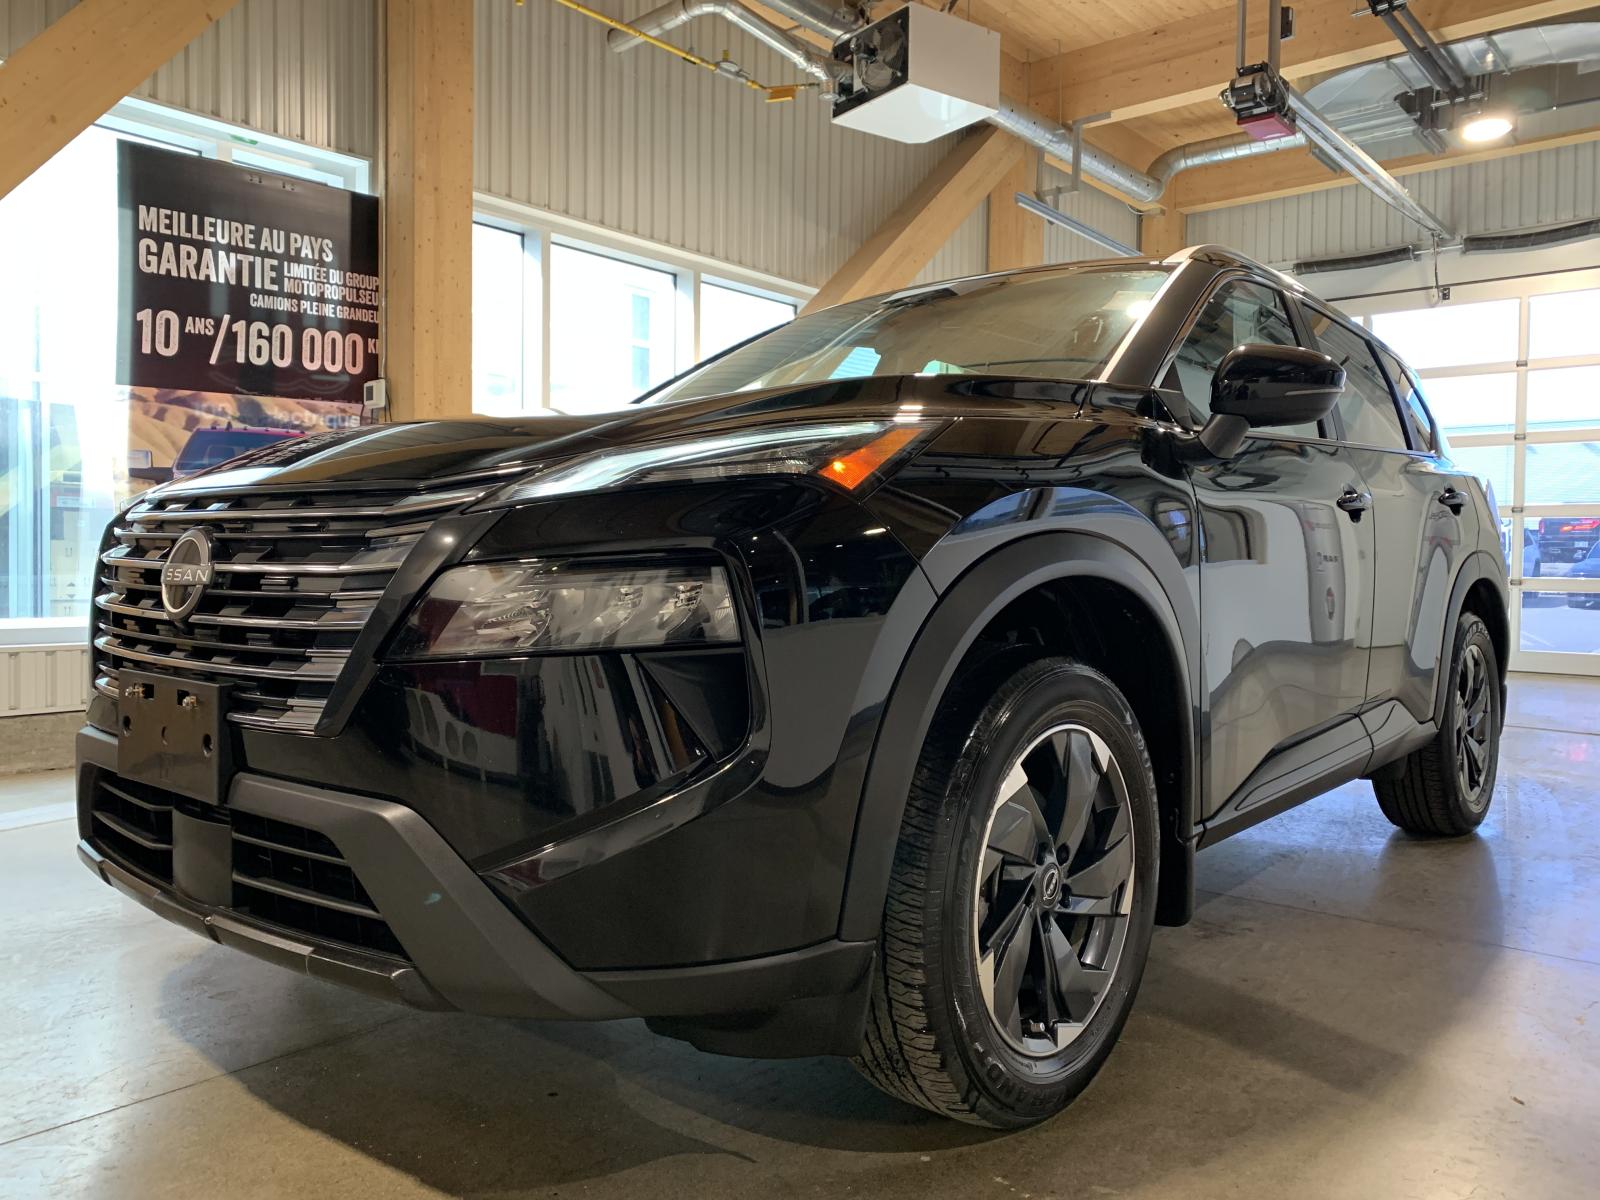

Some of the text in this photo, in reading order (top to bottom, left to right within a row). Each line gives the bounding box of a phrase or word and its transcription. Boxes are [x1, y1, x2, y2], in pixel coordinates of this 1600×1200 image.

[138, 204, 334, 263] MEILLEURE AU PAYS
[138, 238, 278, 291] GARANTIE
[283, 261, 379, 290] LIMITÉE DU GROUP
[250, 293, 299, 313] CAMIONS
[300, 300, 335, 318] PLEINE
[283, 277, 378, 306] MOTOPROPULSEU
[136, 308, 180, 357] 10
[184, 316, 214, 336] ANS
[301, 327, 364, 375] 000
[367, 338, 379, 353] K
[165, 568, 209, 582] SSAN
